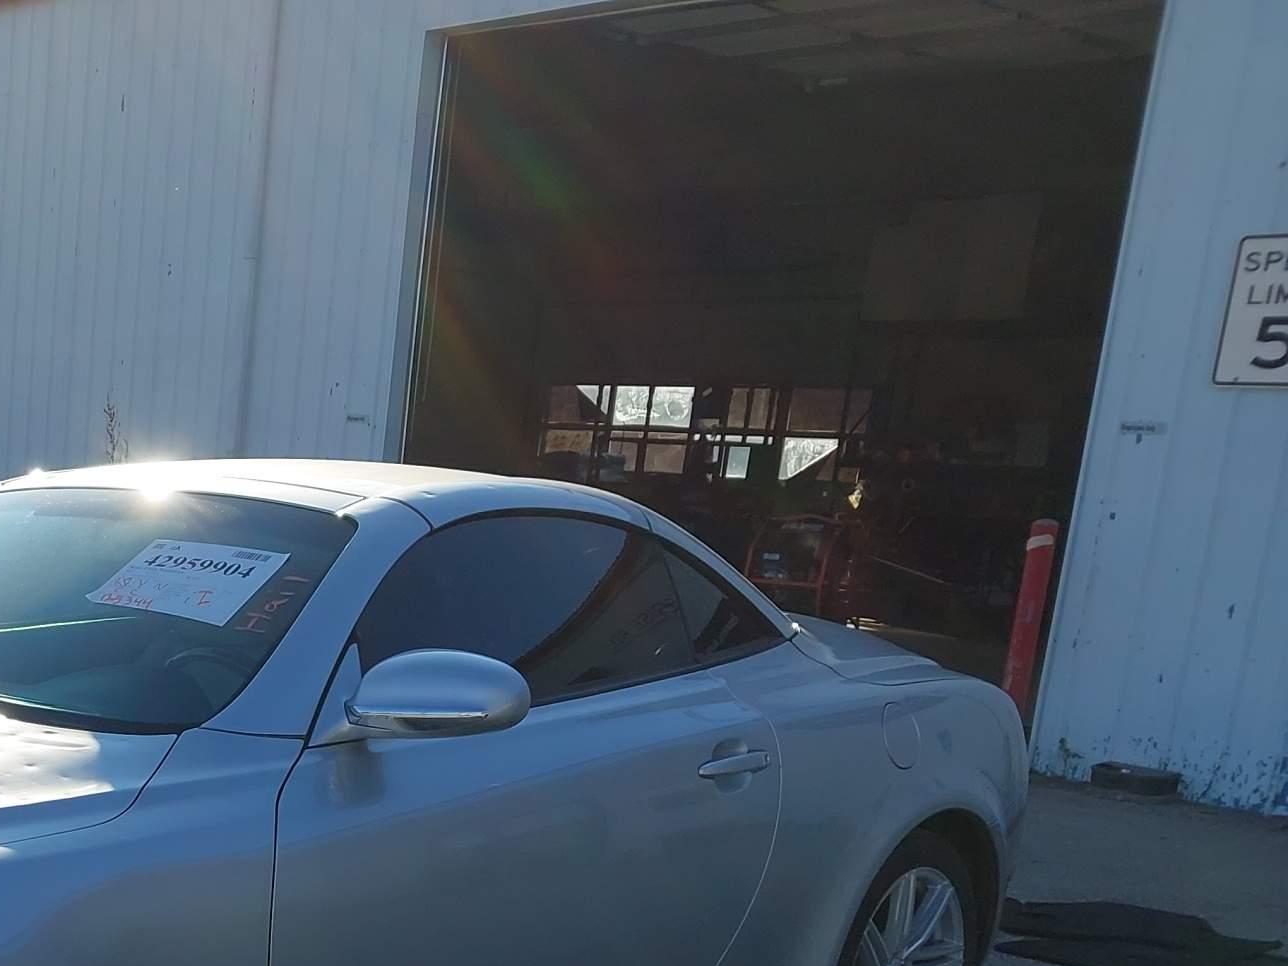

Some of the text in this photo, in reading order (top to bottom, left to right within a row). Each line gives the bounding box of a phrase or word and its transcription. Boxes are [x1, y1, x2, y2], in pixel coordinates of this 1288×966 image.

[1244, 251, 1288, 272] SP
[1250, 316, 1288, 369] 5
[143, 554, 256, 578] 42959904
